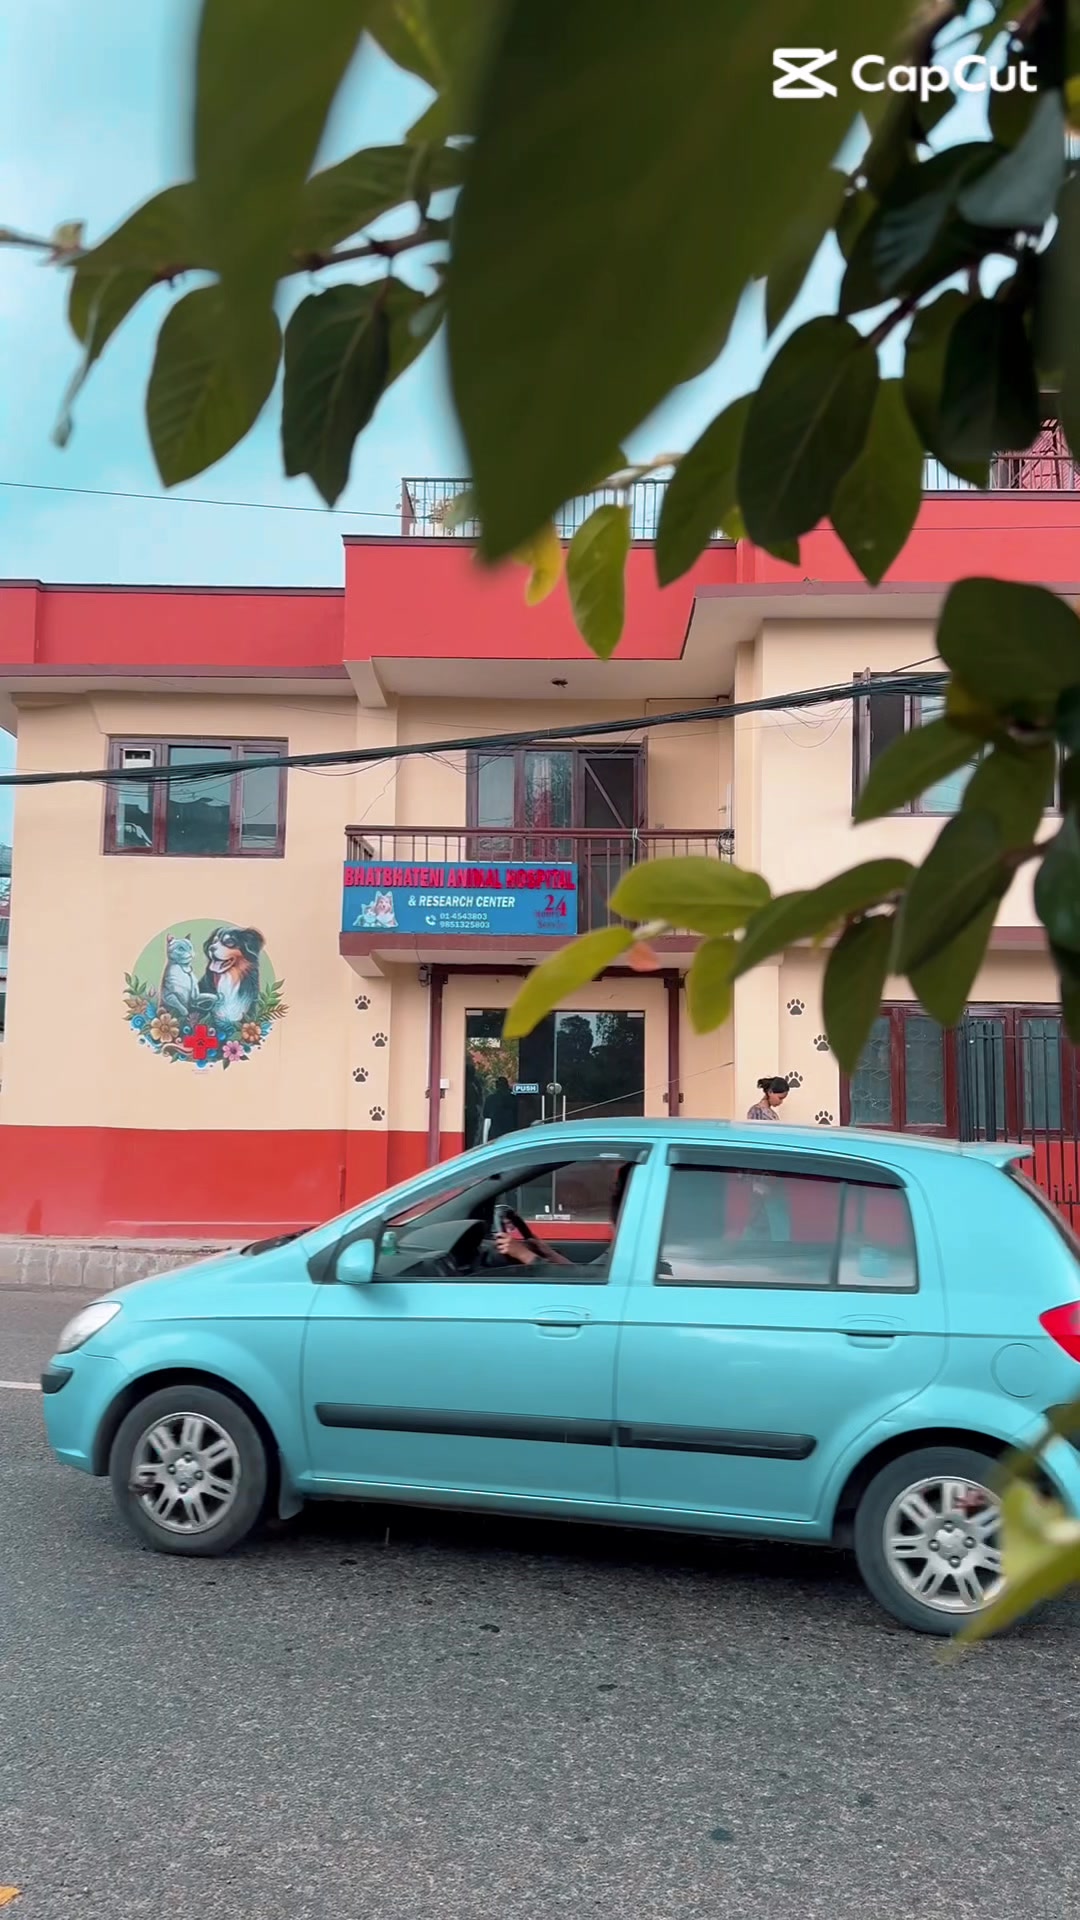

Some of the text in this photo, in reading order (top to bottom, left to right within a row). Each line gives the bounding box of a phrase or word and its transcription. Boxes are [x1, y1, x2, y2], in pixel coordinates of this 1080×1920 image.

[345, 866, 576, 890] BHATBHATENI ANIMAL HOSPITAL
[408, 895, 515, 908] & RESEARCH CENTER
[544, 894, 567, 917] 24
